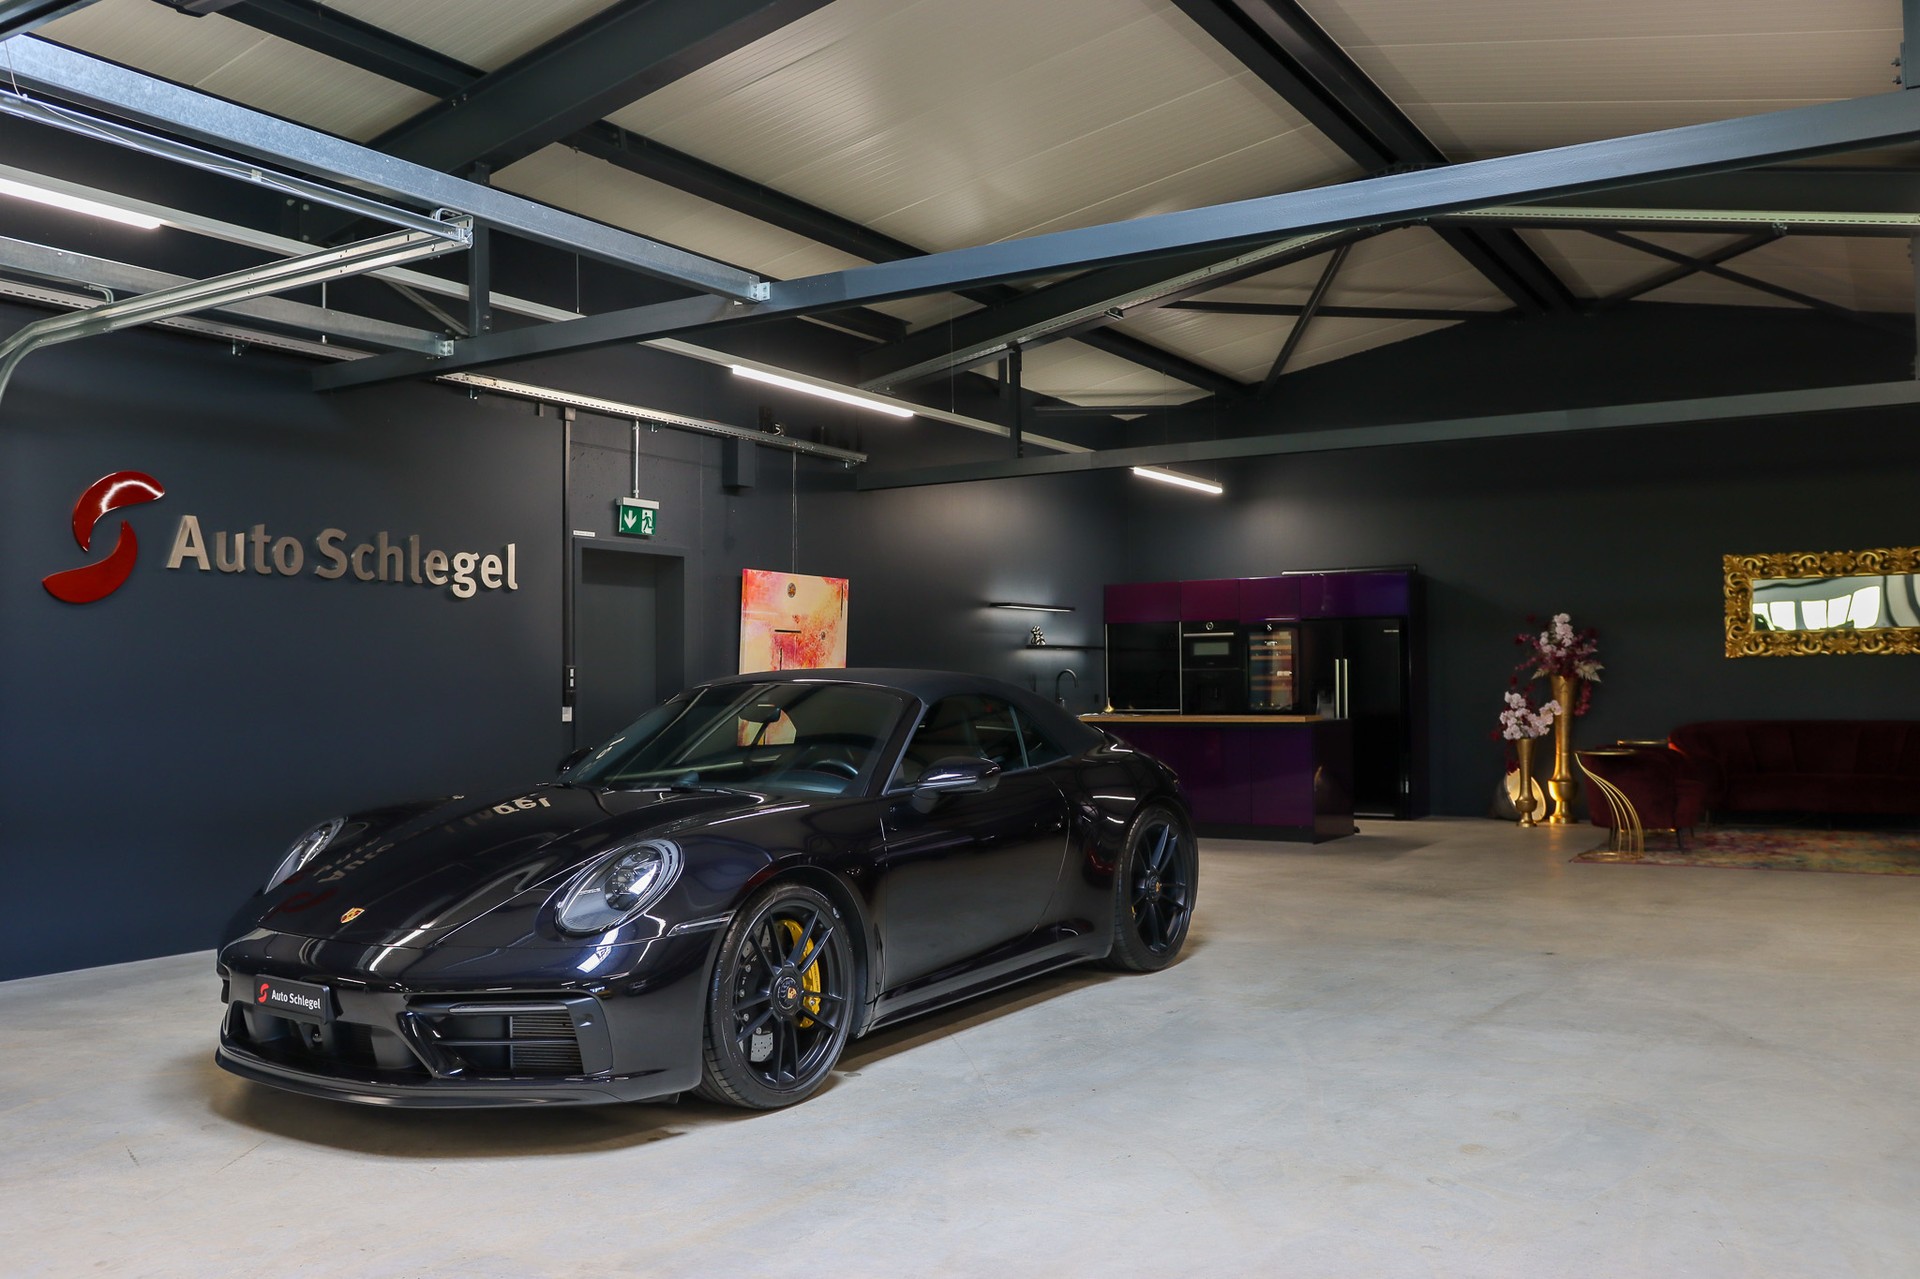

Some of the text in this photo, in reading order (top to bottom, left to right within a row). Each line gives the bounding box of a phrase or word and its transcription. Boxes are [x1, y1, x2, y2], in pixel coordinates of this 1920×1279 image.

[166, 514, 518, 599] Auto Schlegel
[271, 989, 321, 1010] Auto Schlegel
